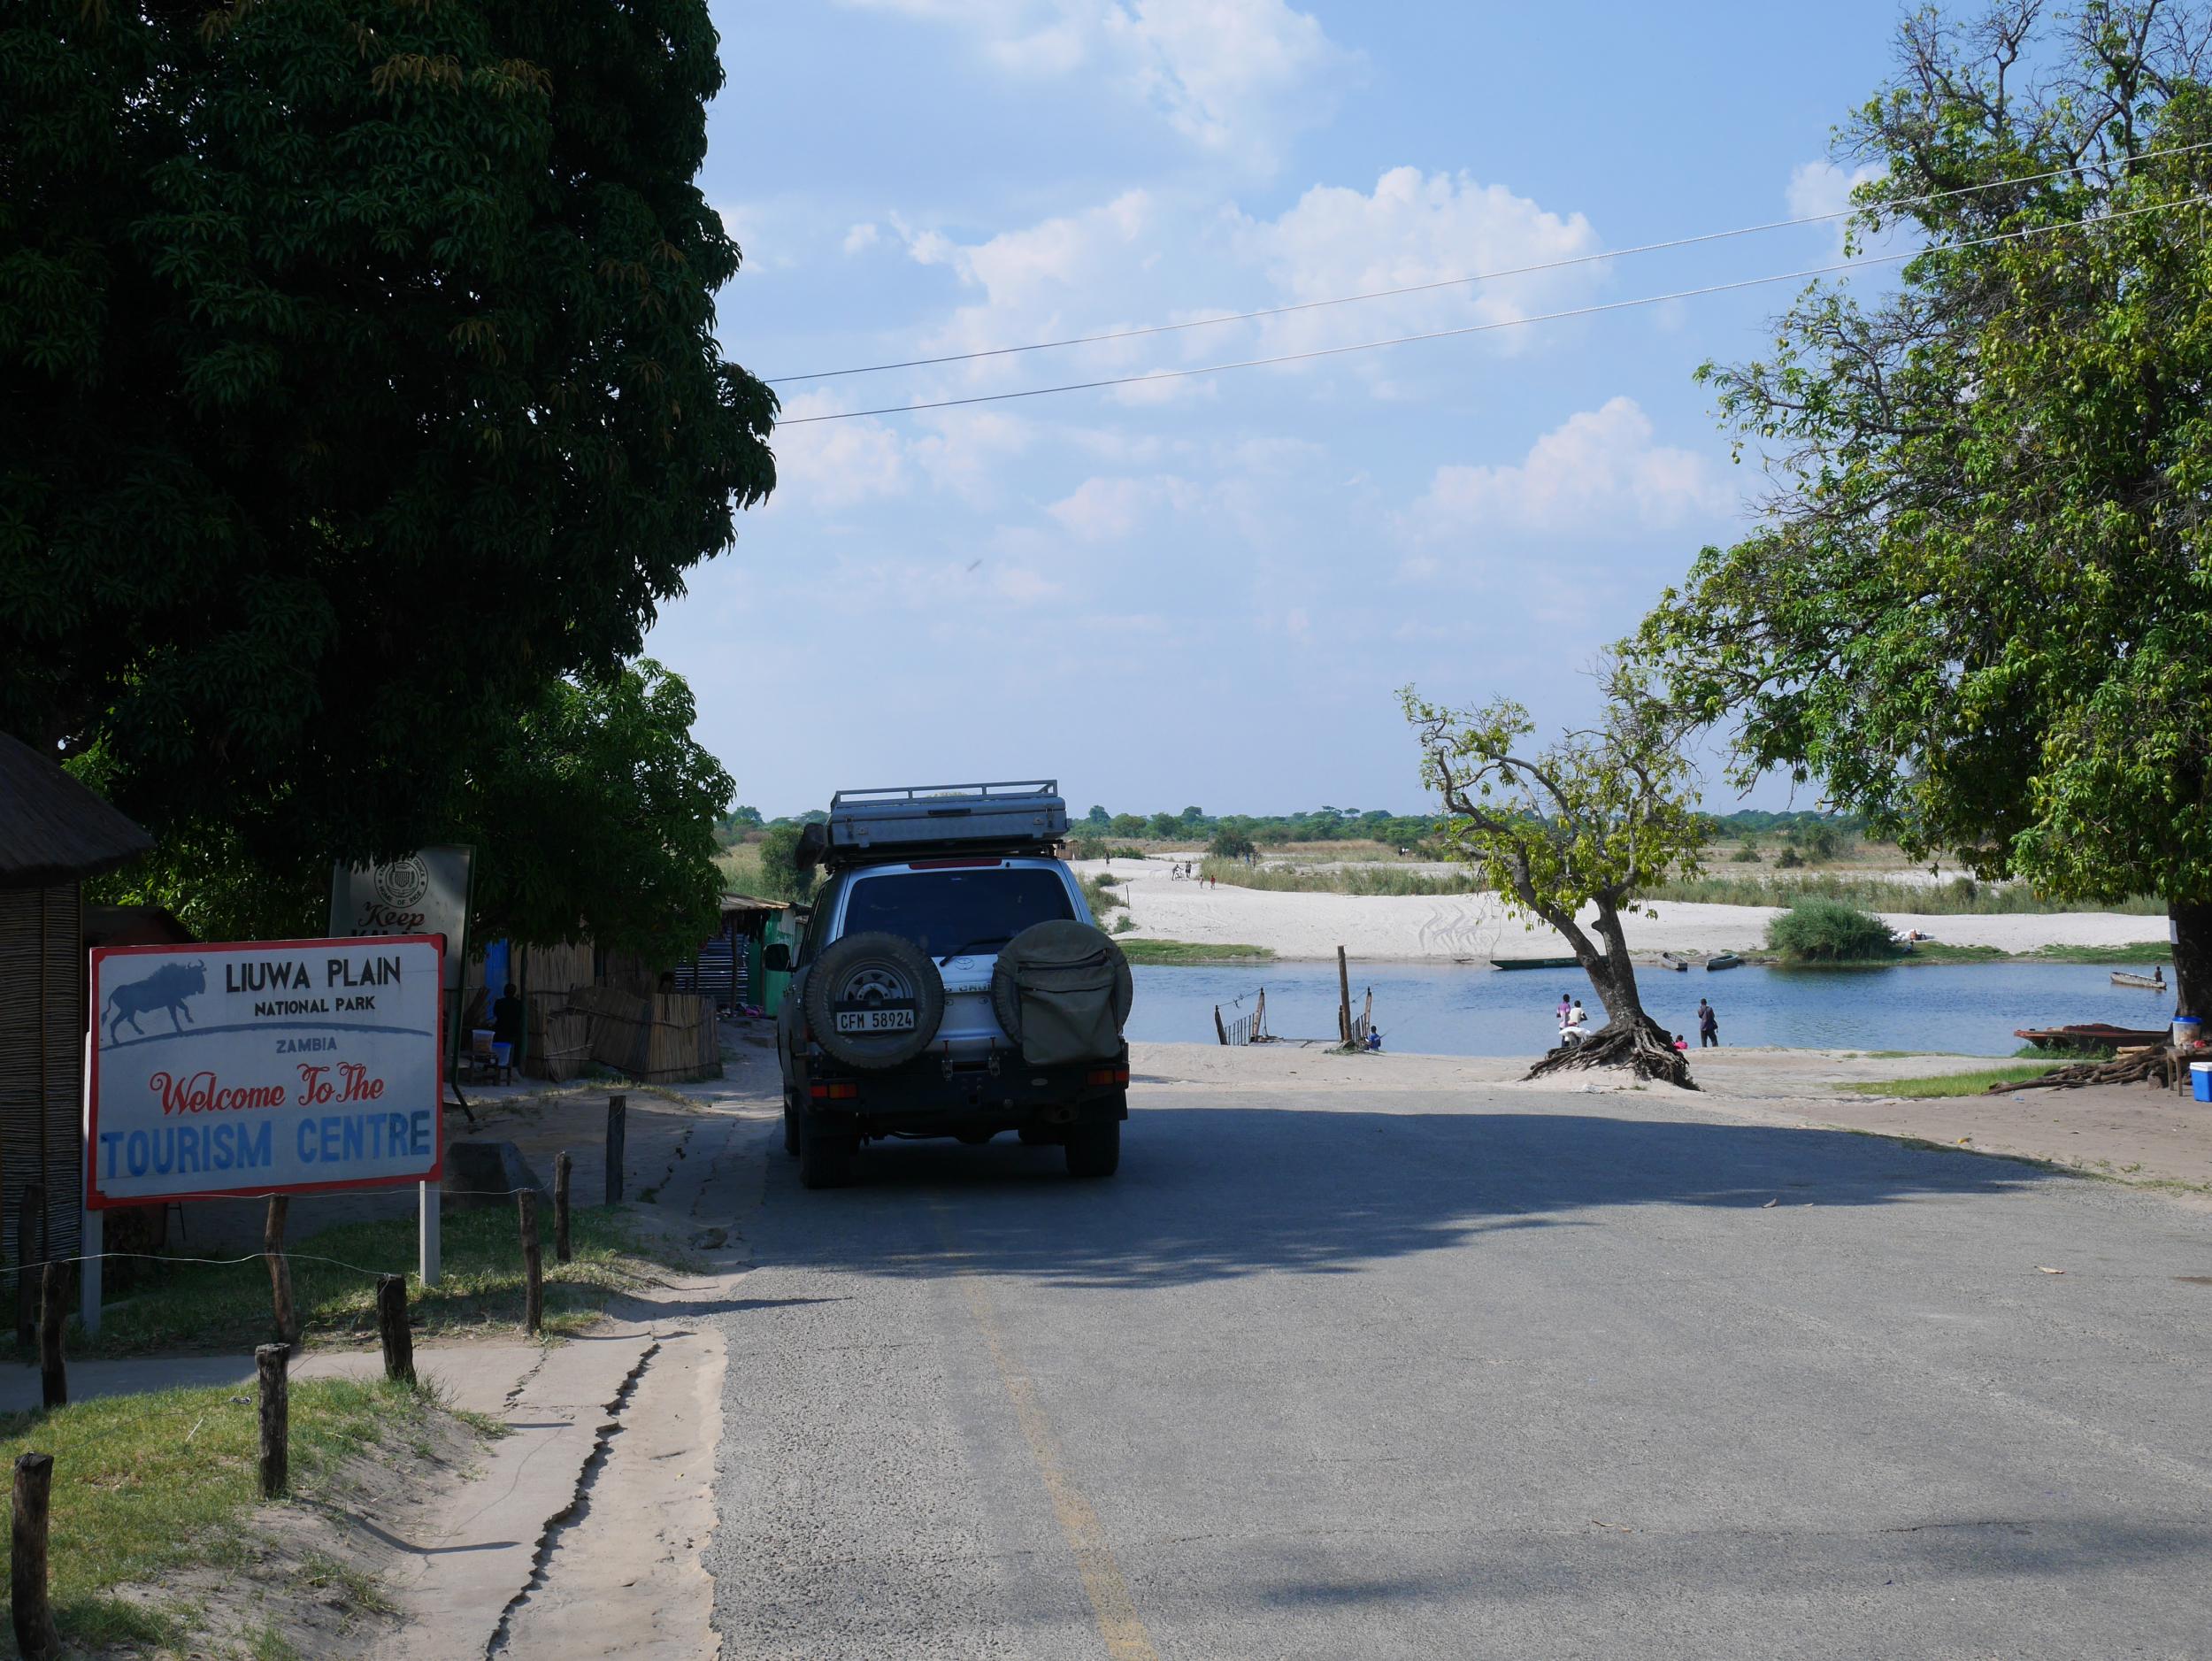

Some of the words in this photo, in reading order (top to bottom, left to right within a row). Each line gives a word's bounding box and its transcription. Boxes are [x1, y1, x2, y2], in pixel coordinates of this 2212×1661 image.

[409, 890, 422, 903] RICE
[358, 901, 426, 930] Keep
[227, 961, 311, 993] LIUWA
[327, 956, 402, 988] PLAIN
[255, 997, 330, 1018] NATIONAL
[335, 995, 376, 1012] PARK
[841, 1014, 864, 1029] CFM
[872, 1012, 912, 1028] 58924
[276, 1037, 338, 1054] ZAMBIA
[150, 1071, 286, 1116] Welcome
[296, 1063, 334, 1106] To
[334, 1061, 384, 1103] The
[100, 1119, 273, 1180] TOURISM
[297, 1110, 431, 1164] CENTRE
